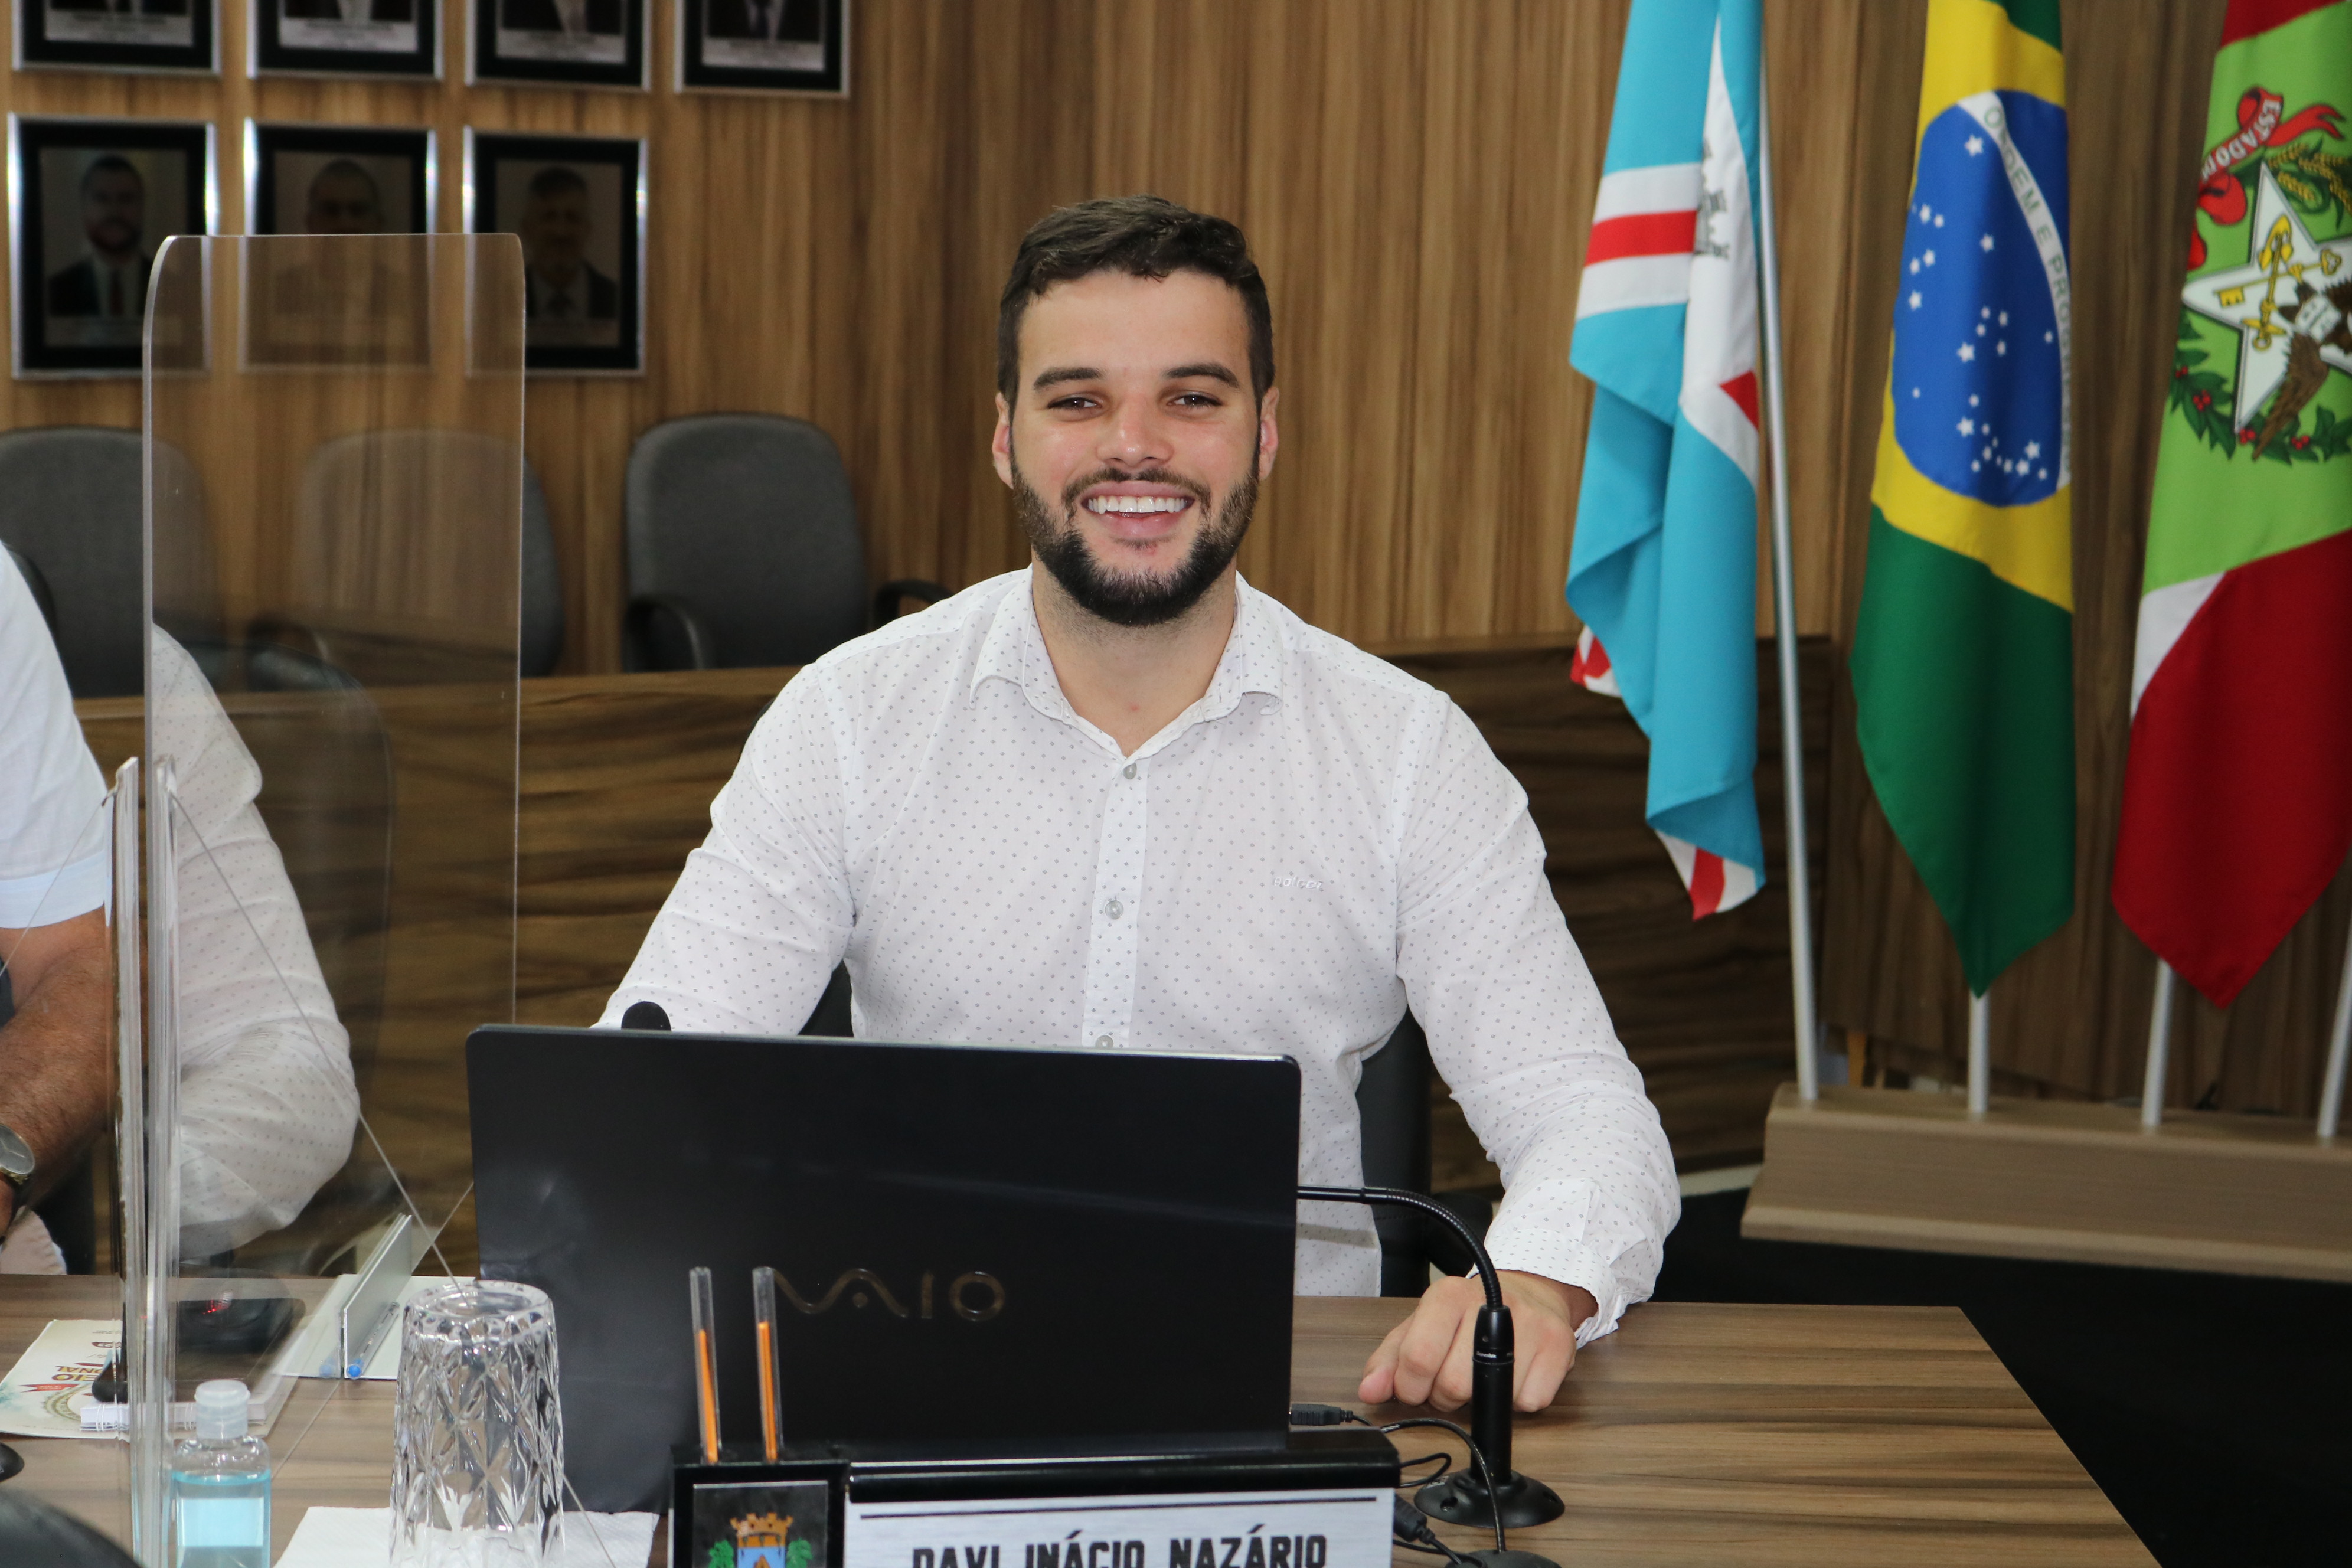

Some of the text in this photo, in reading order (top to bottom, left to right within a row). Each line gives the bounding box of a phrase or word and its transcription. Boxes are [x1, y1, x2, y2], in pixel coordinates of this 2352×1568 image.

[2215, 99, 2282, 167] ESTADO
[2037, 224, 2052, 243] E
[762, 1266, 1005, 1322] VAIO
[913, 1523, 1327, 1568] DAVI INÁCIO NAZÁRIO
